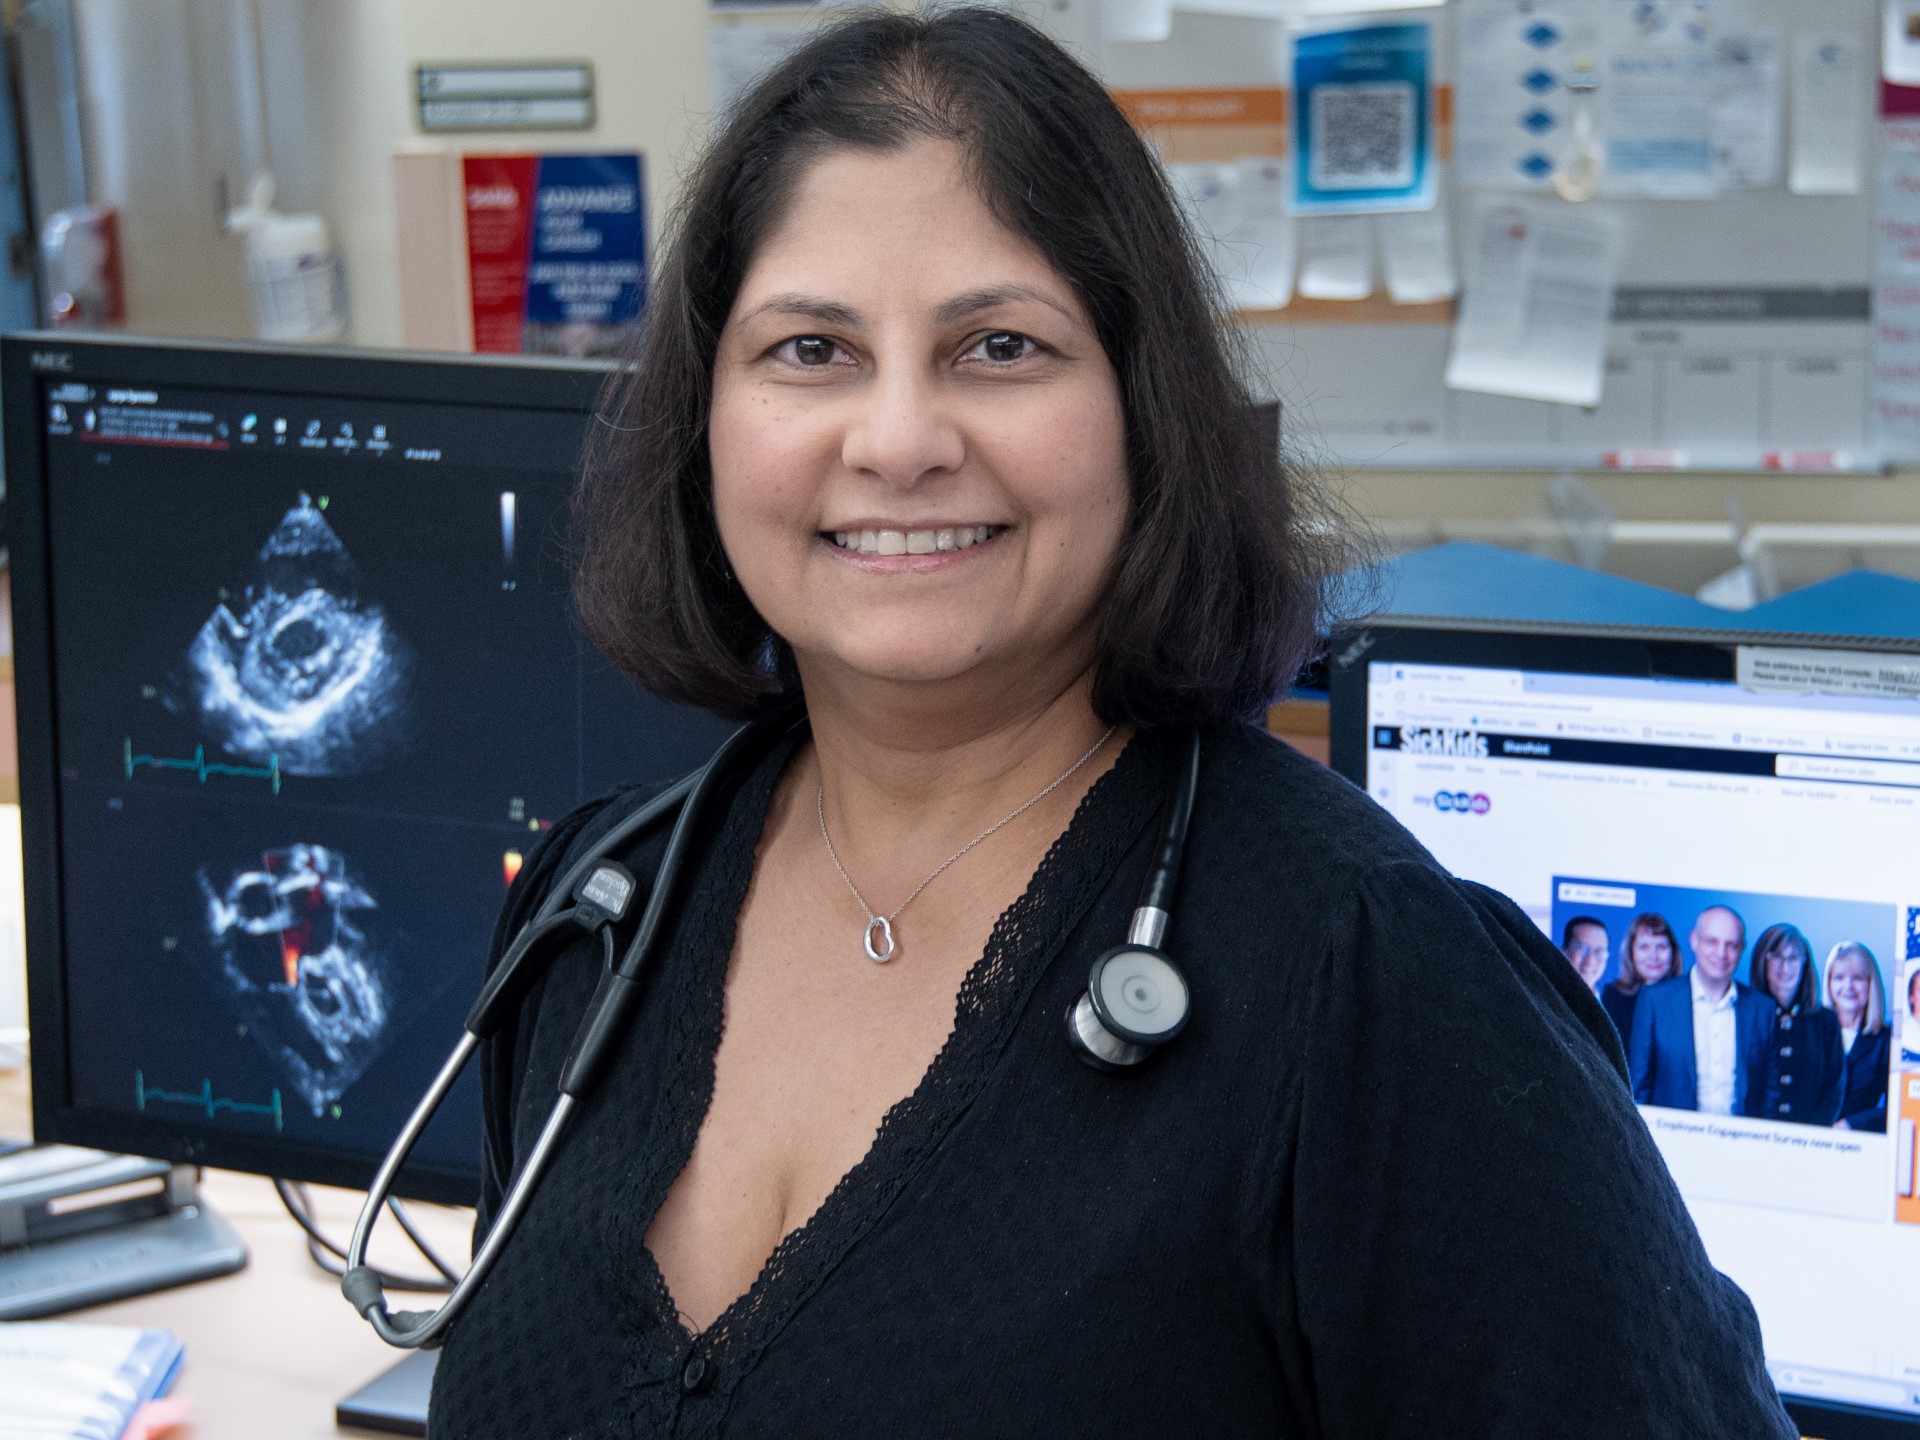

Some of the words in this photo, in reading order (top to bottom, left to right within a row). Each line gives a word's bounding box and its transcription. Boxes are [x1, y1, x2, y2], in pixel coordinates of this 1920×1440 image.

[31, 352, 73, 371] NEC
[1773, 662, 1800, 672] address
[1814, 666, 1826, 674] the
[1399, 725, 1488, 757] SickKids
[1503, 739, 1551, 755] SharePoint
[1656, 1118, 1705, 1134] Employee
[1707, 1124, 1770, 1141] Engagement
[1773, 1132, 1808, 1147] Survey
[1809, 1139, 1833, 1150] now
[1835, 1142, 1862, 1154] open
